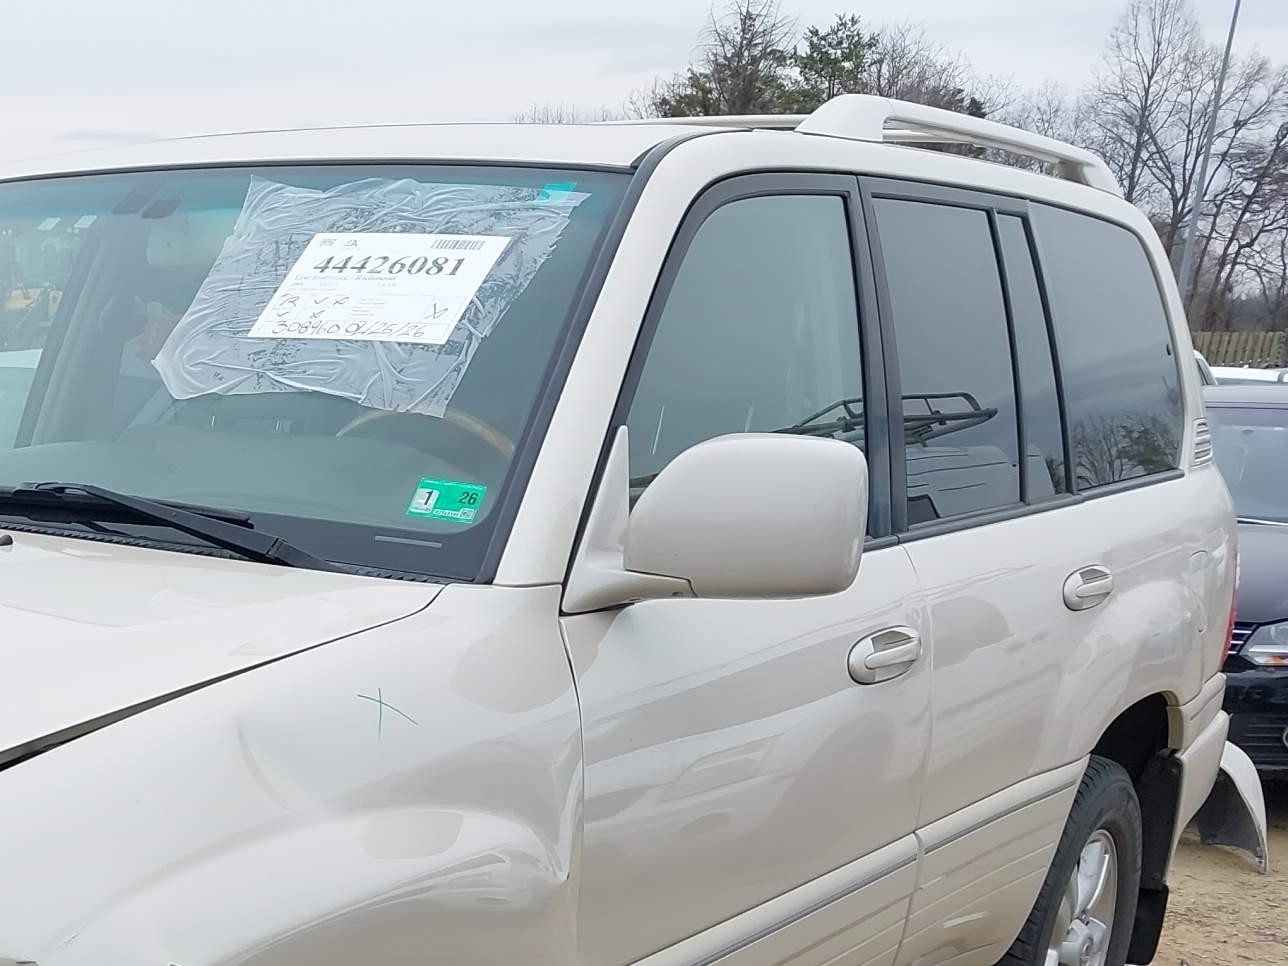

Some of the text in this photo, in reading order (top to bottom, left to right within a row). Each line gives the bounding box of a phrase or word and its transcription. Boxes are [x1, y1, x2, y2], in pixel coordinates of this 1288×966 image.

[312, 255, 466, 277] 44426081
[424, 490, 478, 506] 1 26
